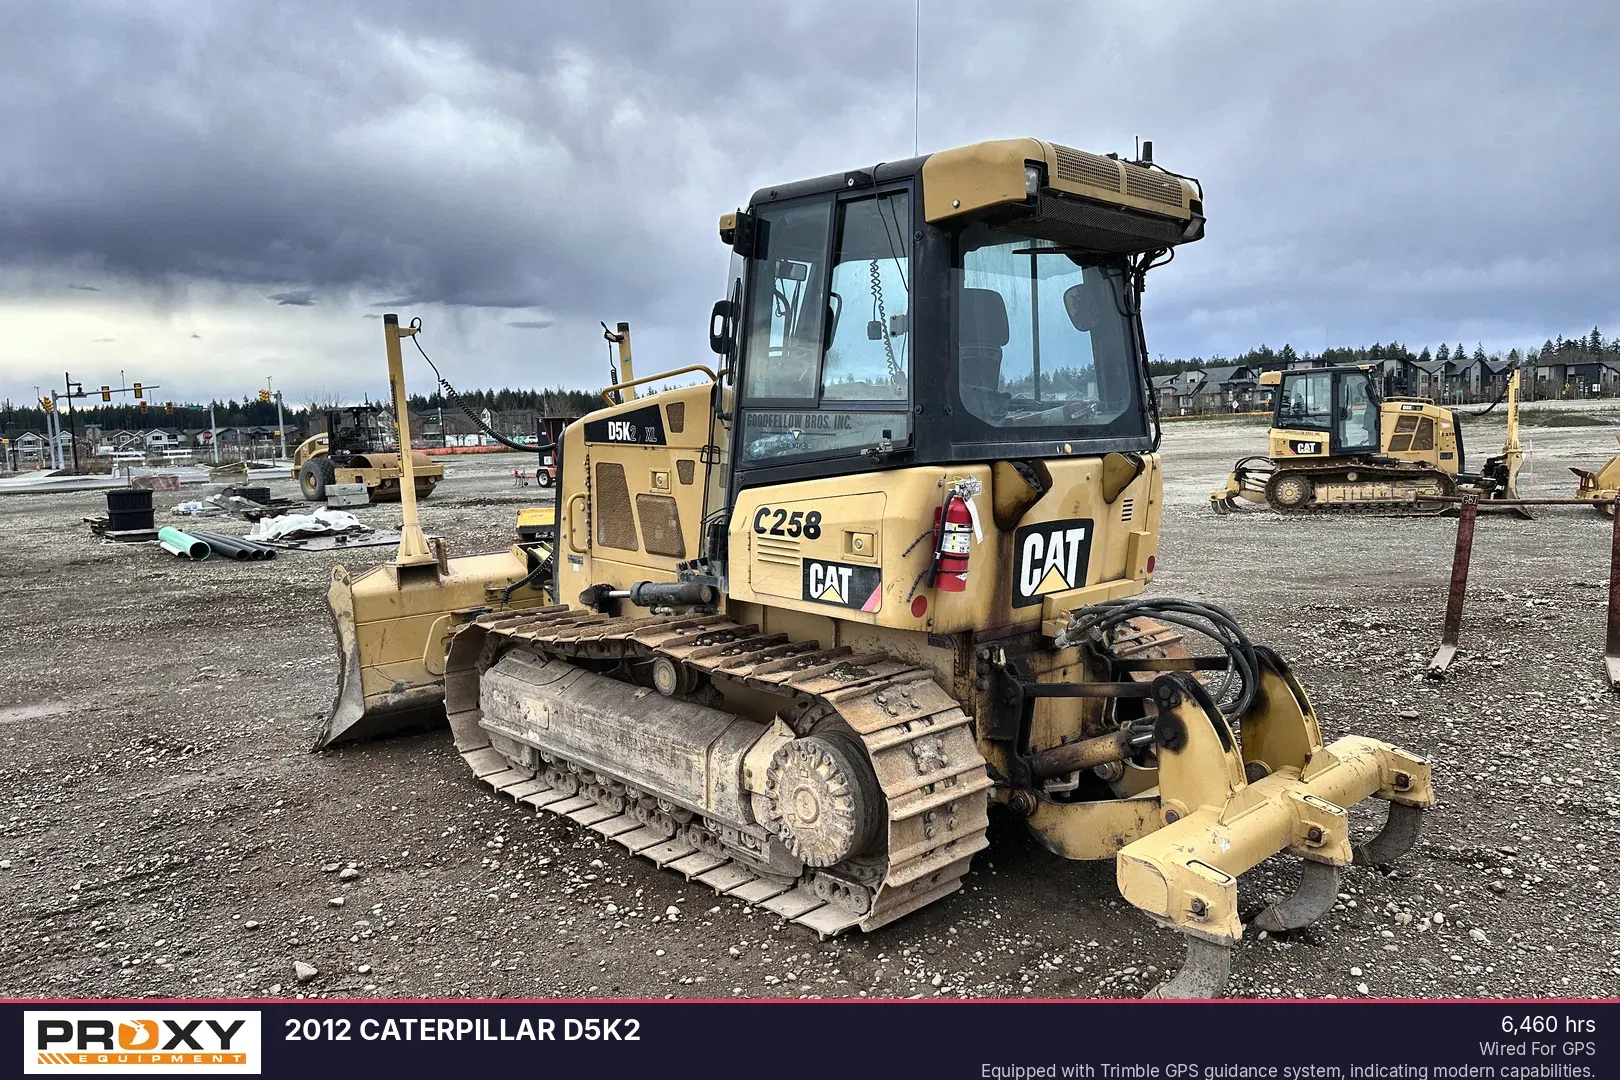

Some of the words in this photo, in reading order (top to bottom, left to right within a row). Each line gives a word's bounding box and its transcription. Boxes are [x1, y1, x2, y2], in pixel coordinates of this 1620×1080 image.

[608, 421, 637, 442] D5K2
[644, 426, 658, 443] XL
[746, 413, 803, 429] GOODFELLOW
[804, 414, 831, 429] BROS.
[834, 415, 852, 430] INC.
[1297, 442, 1316, 454] CAT
[753, 507, 822, 540] C258
[1019, 527, 1086, 598] CAT
[809, 562, 853, 605] CAT
